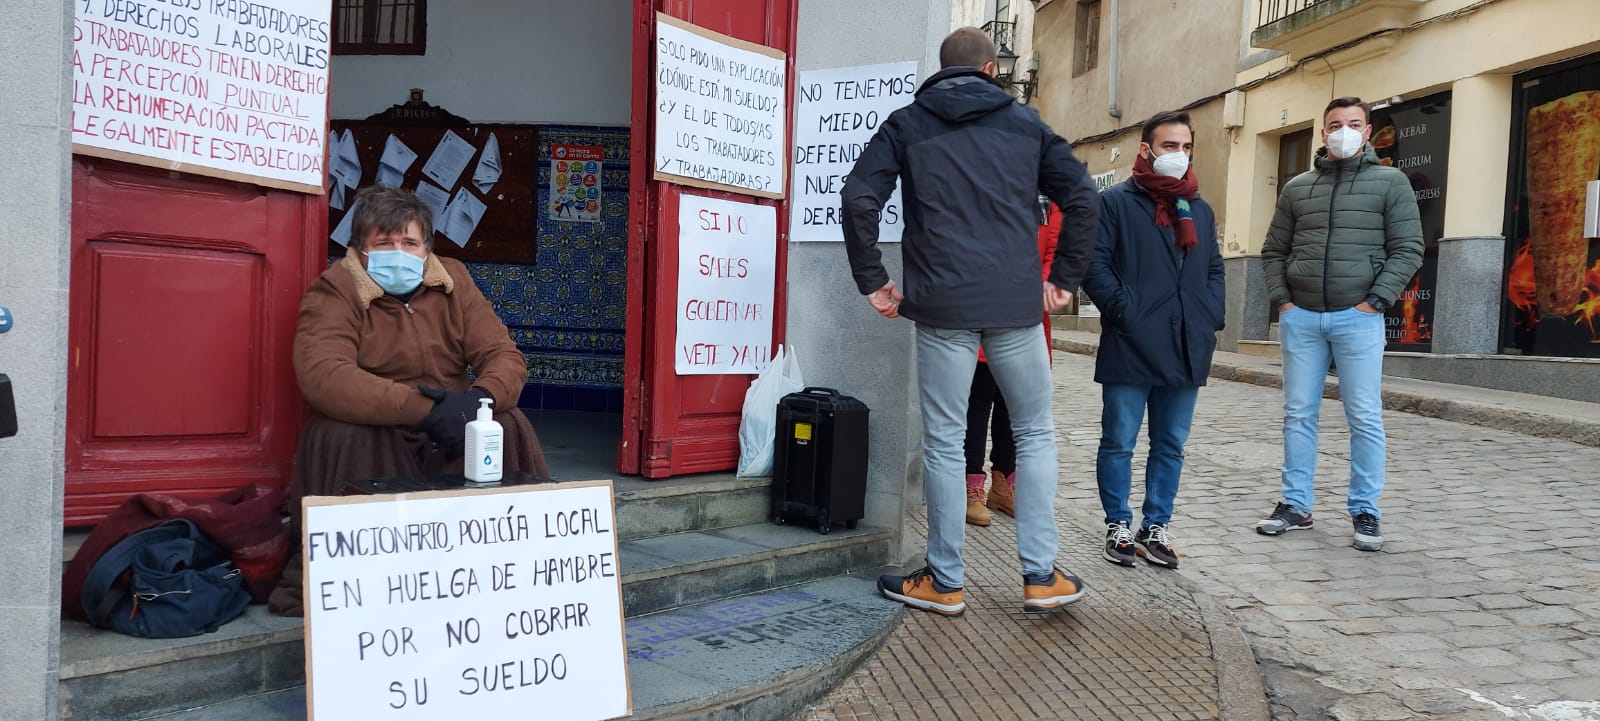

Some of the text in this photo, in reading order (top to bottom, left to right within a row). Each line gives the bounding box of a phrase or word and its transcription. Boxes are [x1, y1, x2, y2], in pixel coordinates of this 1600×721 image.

[104, 0, 199, 38] DERECHOS
[214, 24, 327, 69] LABORALES
[209, 0, 328, 43] TRABAJADORES
[84, 19, 201, 68] TRABAJADORES
[206, 49, 260, 82] TIENEN
[266, 64, 326, 95] DERECHO
[658, 38, 784, 89] SOLO PIDO UNA EXPLICACIÓN
[91, 53, 209, 100] PERCEPCIÓN
[225, 83, 309, 118] PUNTUAL
[659, 61, 778, 118] ¿DÓNDE ESTÁ MI SUELDO?
[800, 73, 915, 103] NO TENEMOS
[73, 80, 320, 148] LA REMUNERACIÓN PACTADA
[684, 105, 698, 122] EL
[703, 110, 717, 128] DE
[723, 113, 772, 143] TODOS/AS
[819, 111, 878, 132] MIEDO
[1400, 124, 1427, 139] KEBAB
[676, 132, 775, 166] LOS TRABAJADORES
[1397, 154, 1432, 170] DURUM
[659, 156, 771, 191] Y TRABAJADORAS?
[699, 209, 748, 235] SI NO
[699, 254, 749, 279] SABES
[686, 299, 763, 321] GOBERNAR
[683, 343, 767, 370] VETE YA!!
[309, 505, 610, 562] FUNCIONARIO, POLICÍA LOCAL
[320, 552, 615, 612] EN HUELGA DE HAMBRE
[358, 626, 418, 661] POR
[446, 617, 480, 648] NO
[505, 602, 591, 640] COBRAR
[388, 653, 567, 709] SU SUELDO
